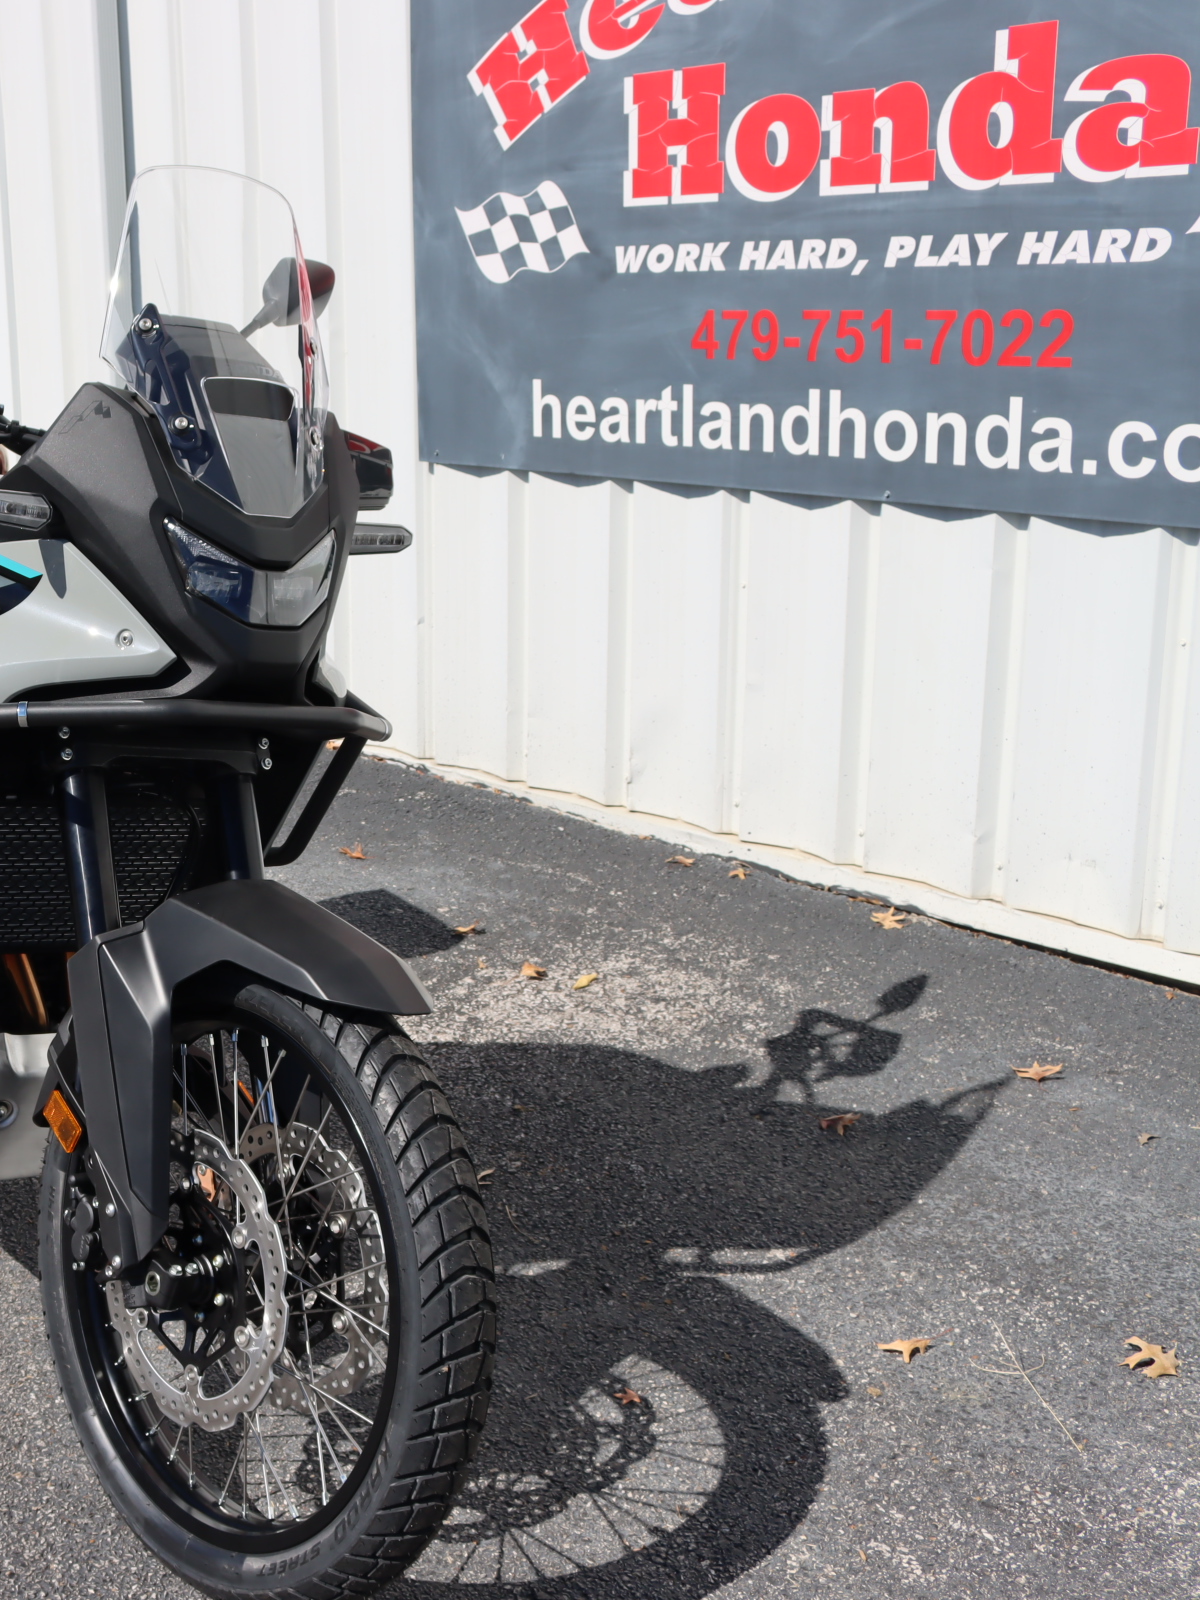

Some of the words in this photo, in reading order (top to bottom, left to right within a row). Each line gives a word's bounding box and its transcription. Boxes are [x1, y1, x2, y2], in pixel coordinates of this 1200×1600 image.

[467, 0, 722, 151] He
[624, 20, 1199, 207] Honda
[615, 241, 731, 274] WORK
[739, 238, 869, 276] HARD,
[884, 232, 1009, 268] PLAY
[1017, 227, 1172, 265] HARD
[691, 309, 1075, 368] 479-751-7022
[532, 379, 1200, 482] heartlandhonda.co
[256, 1541, 322, 1577] STREET
